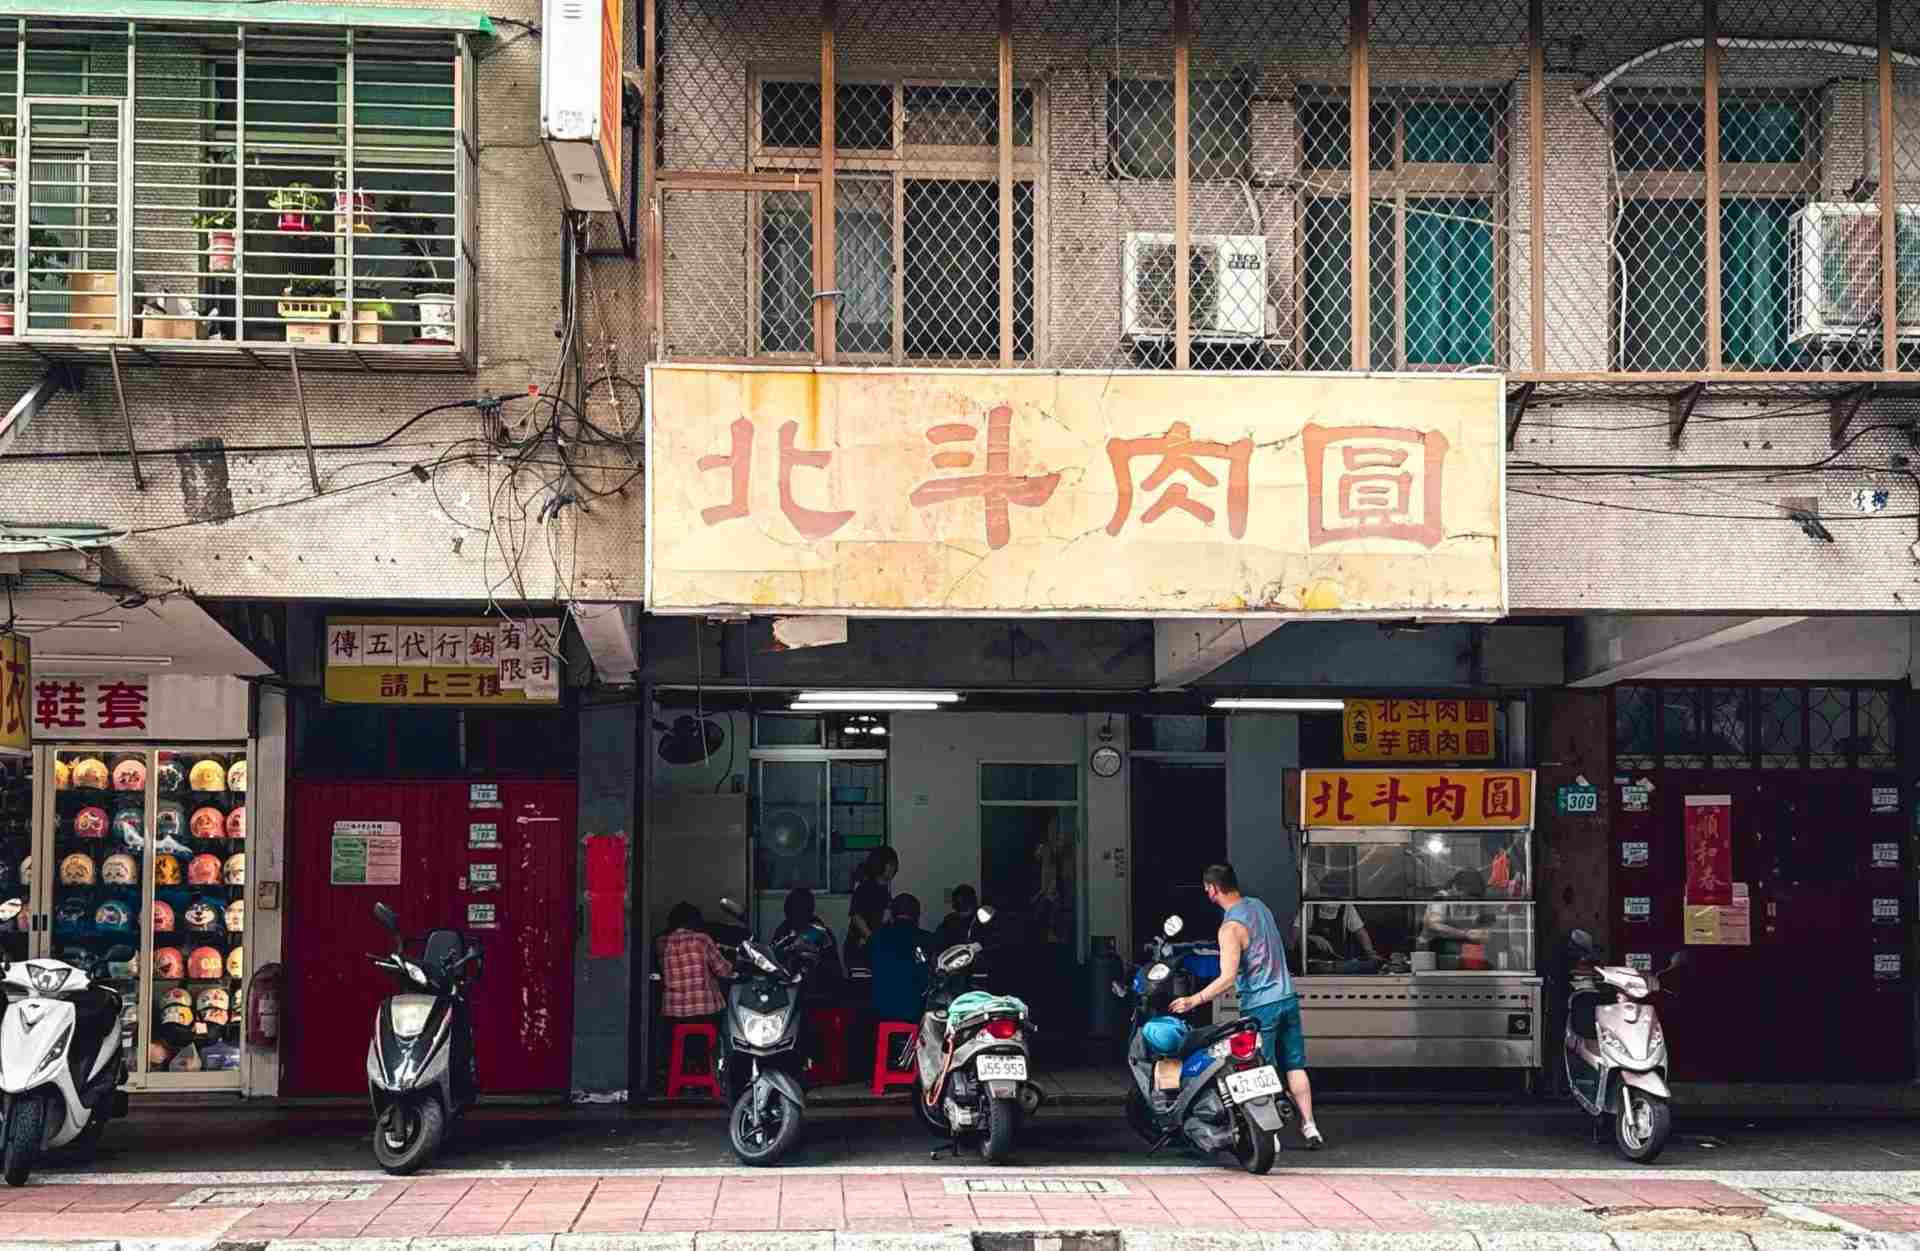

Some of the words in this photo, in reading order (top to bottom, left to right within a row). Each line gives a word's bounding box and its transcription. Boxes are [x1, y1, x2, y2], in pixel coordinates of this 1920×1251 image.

[697, 405, 1448, 550] 北斗肉圓
[331, 631, 496, 659] 傳五代行銷
[34, 681, 148, 729] 鞋套
[1376, 700, 1488, 722] 北斗肉圓
[1376, 729, 1488, 755] 芋頭肉圓
[1312, 776, 1521, 822] 北斗肉圓
[1568, 794, 1595, 809] 309
